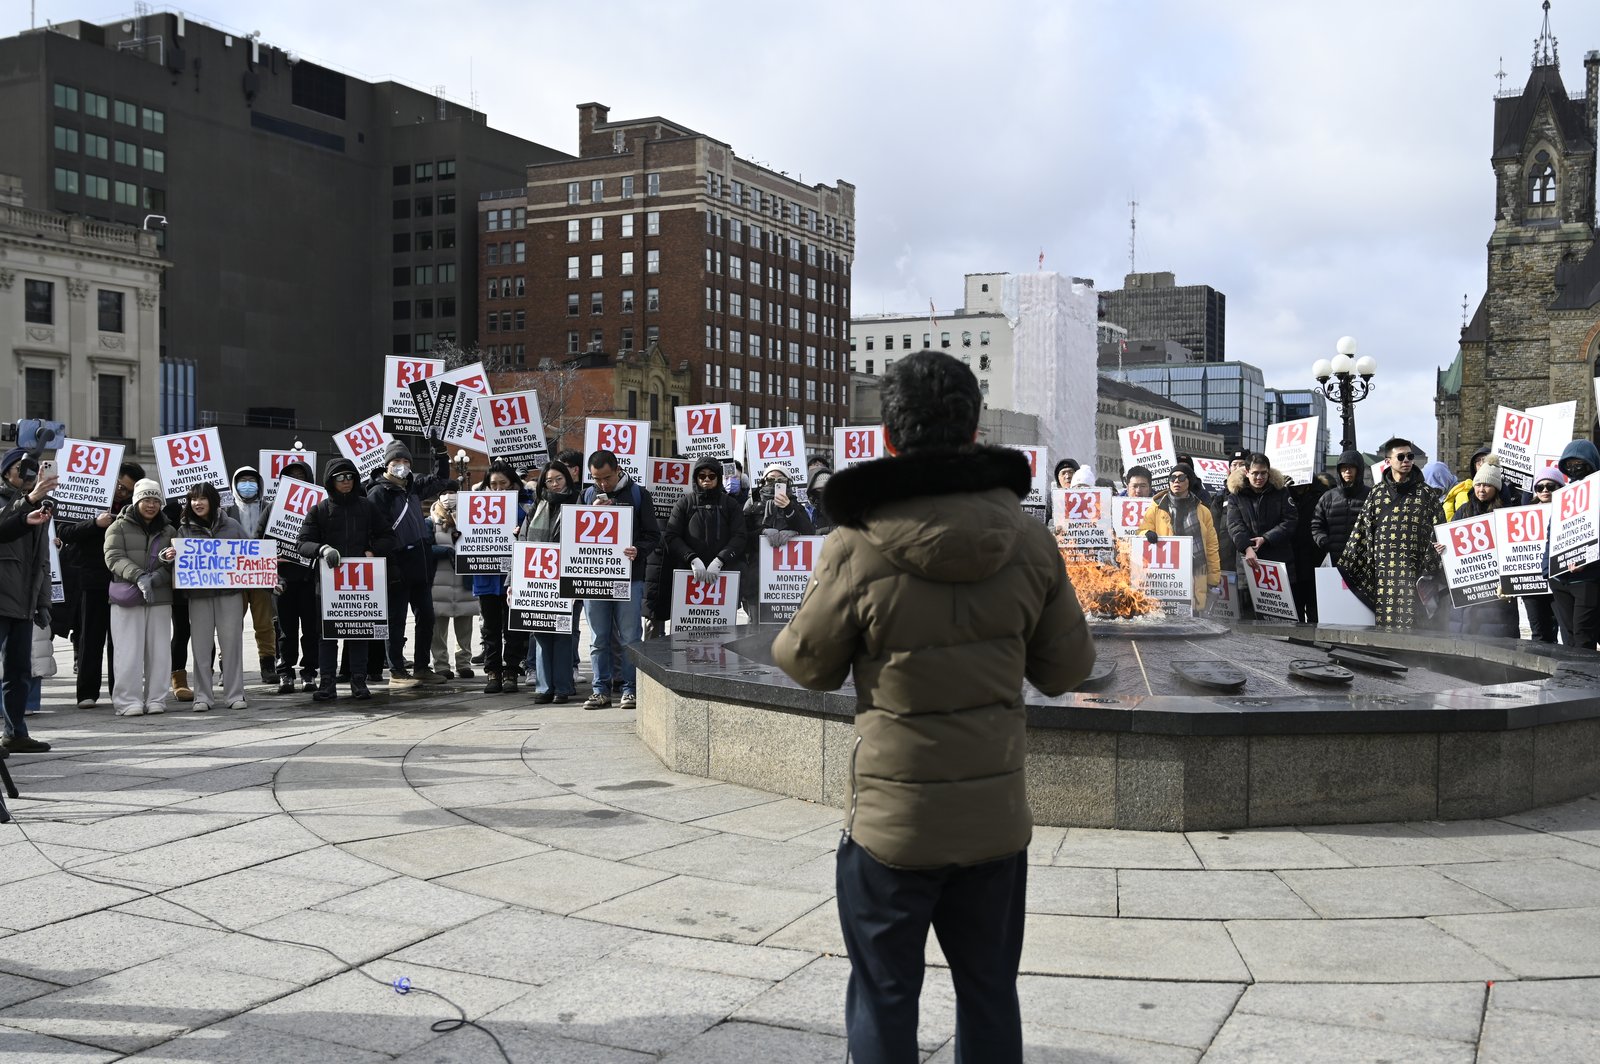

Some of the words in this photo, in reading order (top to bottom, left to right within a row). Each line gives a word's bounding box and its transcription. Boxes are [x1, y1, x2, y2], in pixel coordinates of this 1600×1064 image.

[401, 363, 426, 388] 31
[416, 394, 422, 402] NO
[421, 390, 427, 398] NO
[440, 394, 446, 403] NO
[447, 394, 453, 403] NO
[458, 391, 466, 405] IRCC
[434, 404, 443, 425] RESULTS
[460, 398, 473, 426] WAITING
[496, 398, 526, 426] 31
[448, 406, 460, 439] RESPONSE
[466, 406, 478, 433] MONTHS
[691, 410, 716, 435] 27
[456, 426, 464, 437] FOR
[500, 427, 528, 436] MONTHS
[1280, 424, 1303, 446] 12
[1506, 414, 1530, 444] 30
[350, 425, 378, 453] 39
[494, 436, 522, 445] WAITING
[601, 425, 632, 454] 39
[762, 432, 790, 458] 22
[849, 432, 871, 457] 31
[1133, 427, 1155, 454] 27
[173, 435, 205, 465] 39
[508, 442, 542, 451] RESPONSE
[686, 444, 712, 452] WAITING
[1504, 442, 1526, 453] MONTHS
[72, 446, 105, 475] 39
[361, 448, 384, 463] MONTHS
[696, 450, 729, 458] RESPONSE
[1137, 454, 1161, 464] MONTHS
[1498, 448, 1519, 459] WAITING
[1520, 454, 1530, 462] FOR
[358, 455, 382, 471] WAITING
[1158, 460, 1169, 468] FOR
[1505, 457, 1532, 471] RESPONSE
[177, 465, 208, 476] MONTHS
[658, 463, 684, 484] 13
[68, 476, 99, 485] MONTHS
[171, 475, 201, 485] WAITING
[58, 484, 89, 492] WAITING
[168, 486, 184, 494] IRCC
[52, 491, 68, 499] IRCC
[69, 493, 108, 503] RESPONSE
[289, 487, 317, 515] 40
[1563, 483, 1587, 518] 30
[472, 496, 502, 524] 35
[1069, 493, 1097, 519] 23
[580, 511, 614, 543] 22
[1511, 511, 1540, 542] 30
[1562, 516, 1585, 531] MONTHS
[270, 527, 284, 536] IRCC
[1557, 526, 1578, 542] WAITING
[1579, 522, 1592, 531] FOR
[1455, 523, 1489, 555] 38
[1553, 543, 1564, 552] IRCC
[1564, 529, 1595, 547] RESPONSE
[184, 539, 221, 554] STOP
[227, 541, 259, 555] THE
[1512, 544, 1541, 553] MONTHS
[570, 557, 603, 565] WAITING
[779, 542, 806, 570] 11
[1148, 542, 1174, 569] 11
[1460, 553, 1492, 565] MONTHS
[1506, 554, 1534, 562] WAITING
[528, 549, 558, 579] 43
[584, 567, 626, 575] RESPONSE
[1455, 563, 1486, 575] WAITING
[340, 563, 368, 590] 11
[1256, 564, 1278, 591] 25
[1453, 576, 1470, 585] IRCC
[527, 582, 557, 590] MONTHS
[690, 576, 721, 605] 34
[1523, 582, 1546, 590] RESULTS
[520, 590, 548, 598] WAITING
[1260, 591, 1281, 600] MONTHS
[531, 600, 568, 608] RESPONSE
[1257, 598, 1278, 606] WAITING
[1267, 605, 1294, 616] RESPONSE
